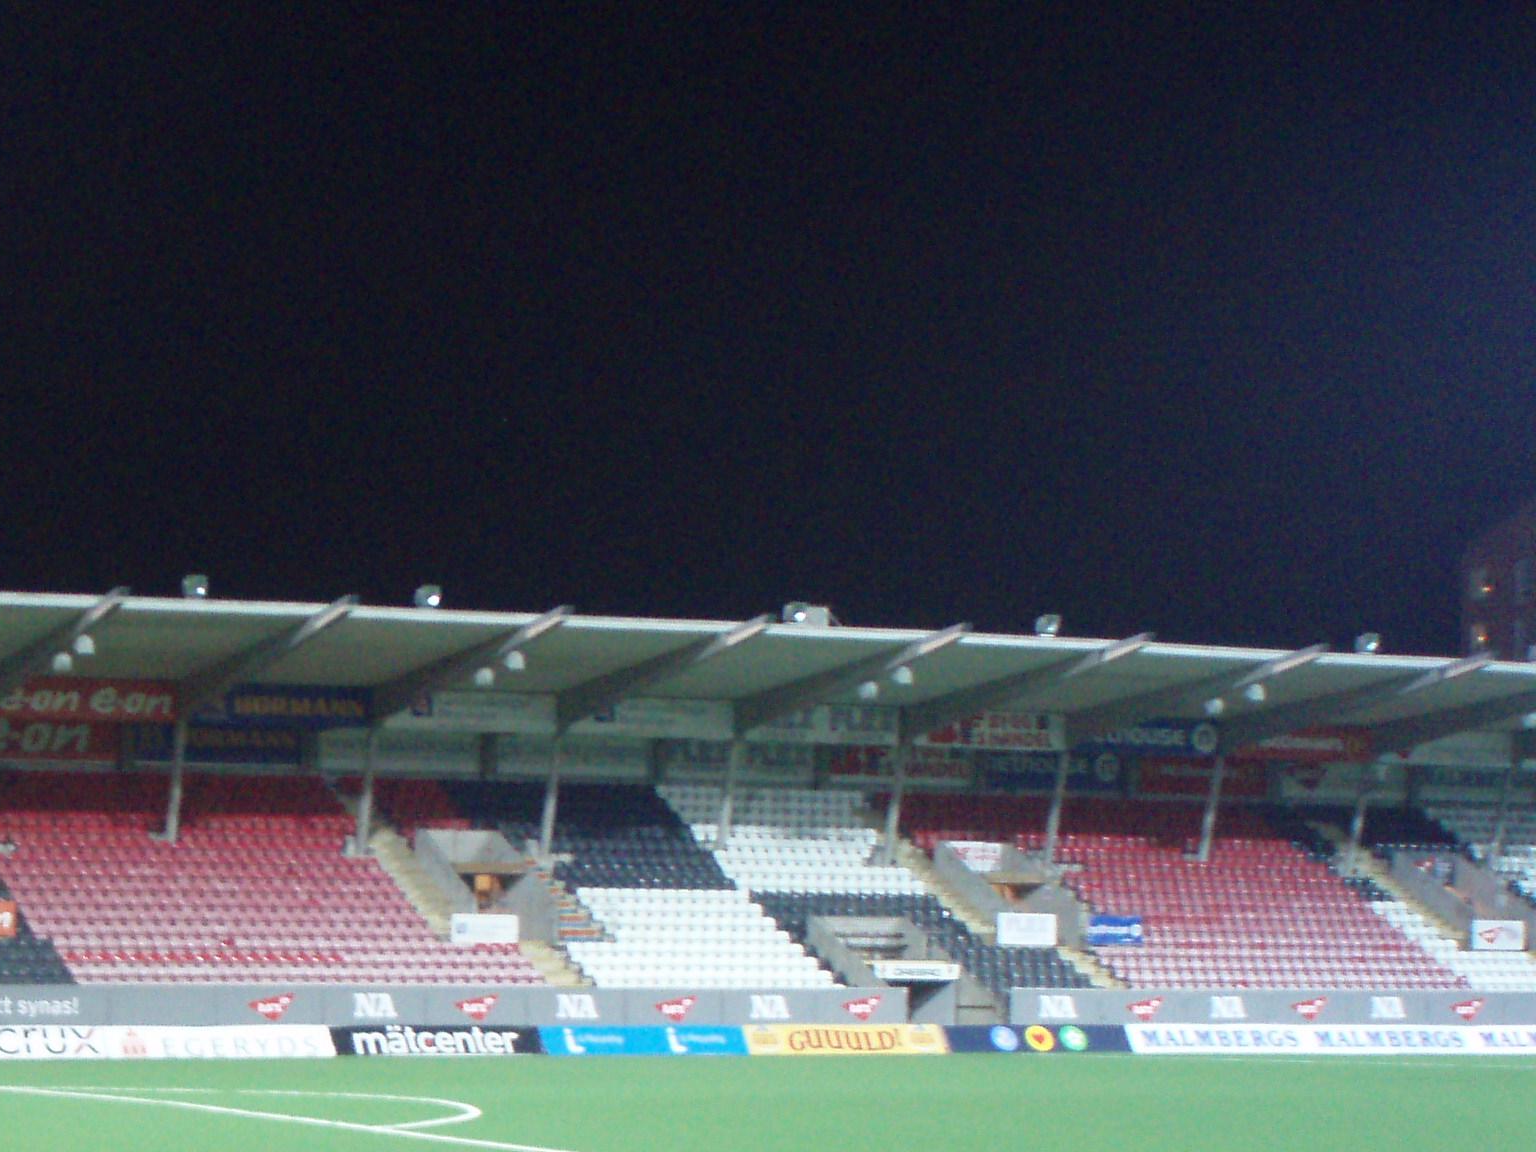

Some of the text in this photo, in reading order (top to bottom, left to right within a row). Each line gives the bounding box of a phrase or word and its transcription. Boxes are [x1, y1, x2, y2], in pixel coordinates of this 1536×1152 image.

[18, 997, 79, 1018] synas!
[354, 993, 398, 1018] NA
[556, 994, 599, 1019] NA
[750, 994, 790, 1019] NA
[161, 1036, 321, 1056] EGERYDS
[352, 1025, 519, 1055] mätcenter
[1140, 1030, 1298, 1048] MALMBERGS
[1313, 1031, 1465, 1048] MALMBERGS
